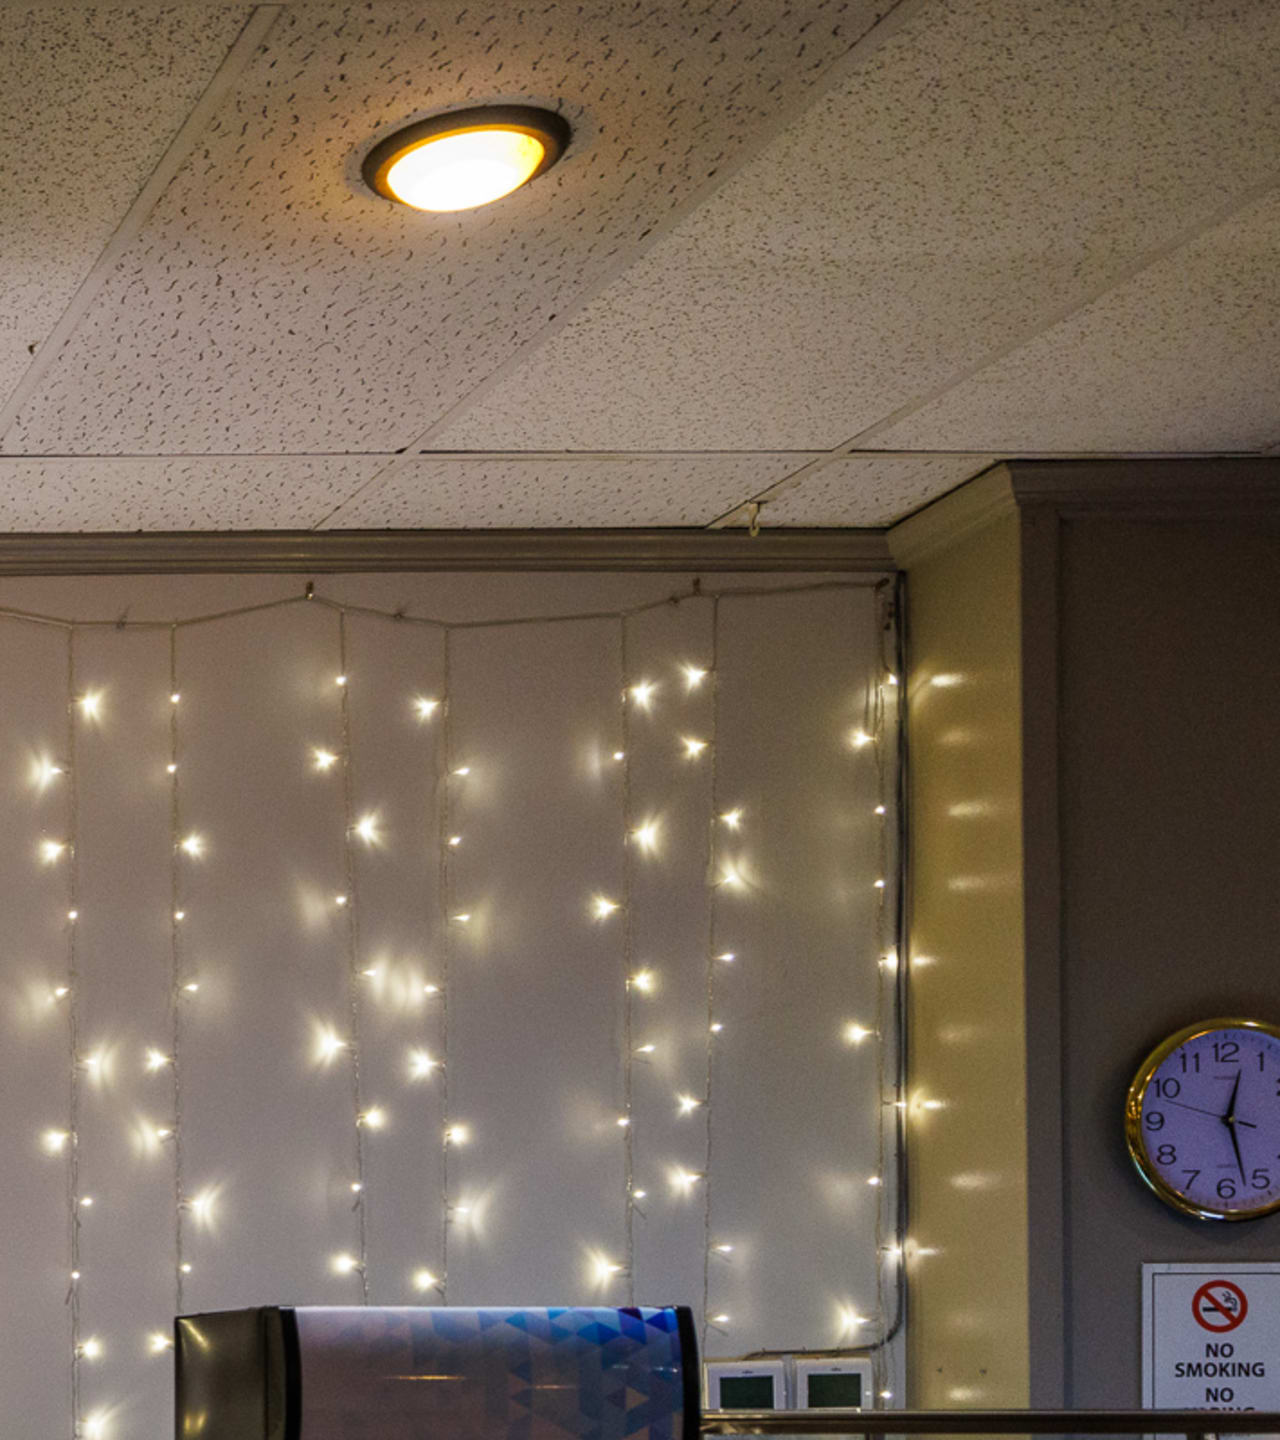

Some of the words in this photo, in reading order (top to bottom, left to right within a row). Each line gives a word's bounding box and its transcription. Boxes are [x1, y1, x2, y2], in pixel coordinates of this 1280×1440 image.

[1179, 1052, 1200, 1073] 11
[1212, 1041, 1240, 1063] 12
[1257, 1051, 1265, 1072] 1
[1154, 1077, 1181, 1099] 10
[1145, 1111, 1165, 1131] 9
[1156, 1144, 1177, 1165] 8
[1182, 1169, 1201, 1190] 7
[1216, 1178, 1236, 1199] 6
[1251, 1169, 1271, 1190] 5
[1205, 1343, 1234, 1358] NO
[1175, 1362, 1265, 1378] SMOKING
[1205, 1387, 1234, 1403] NO
